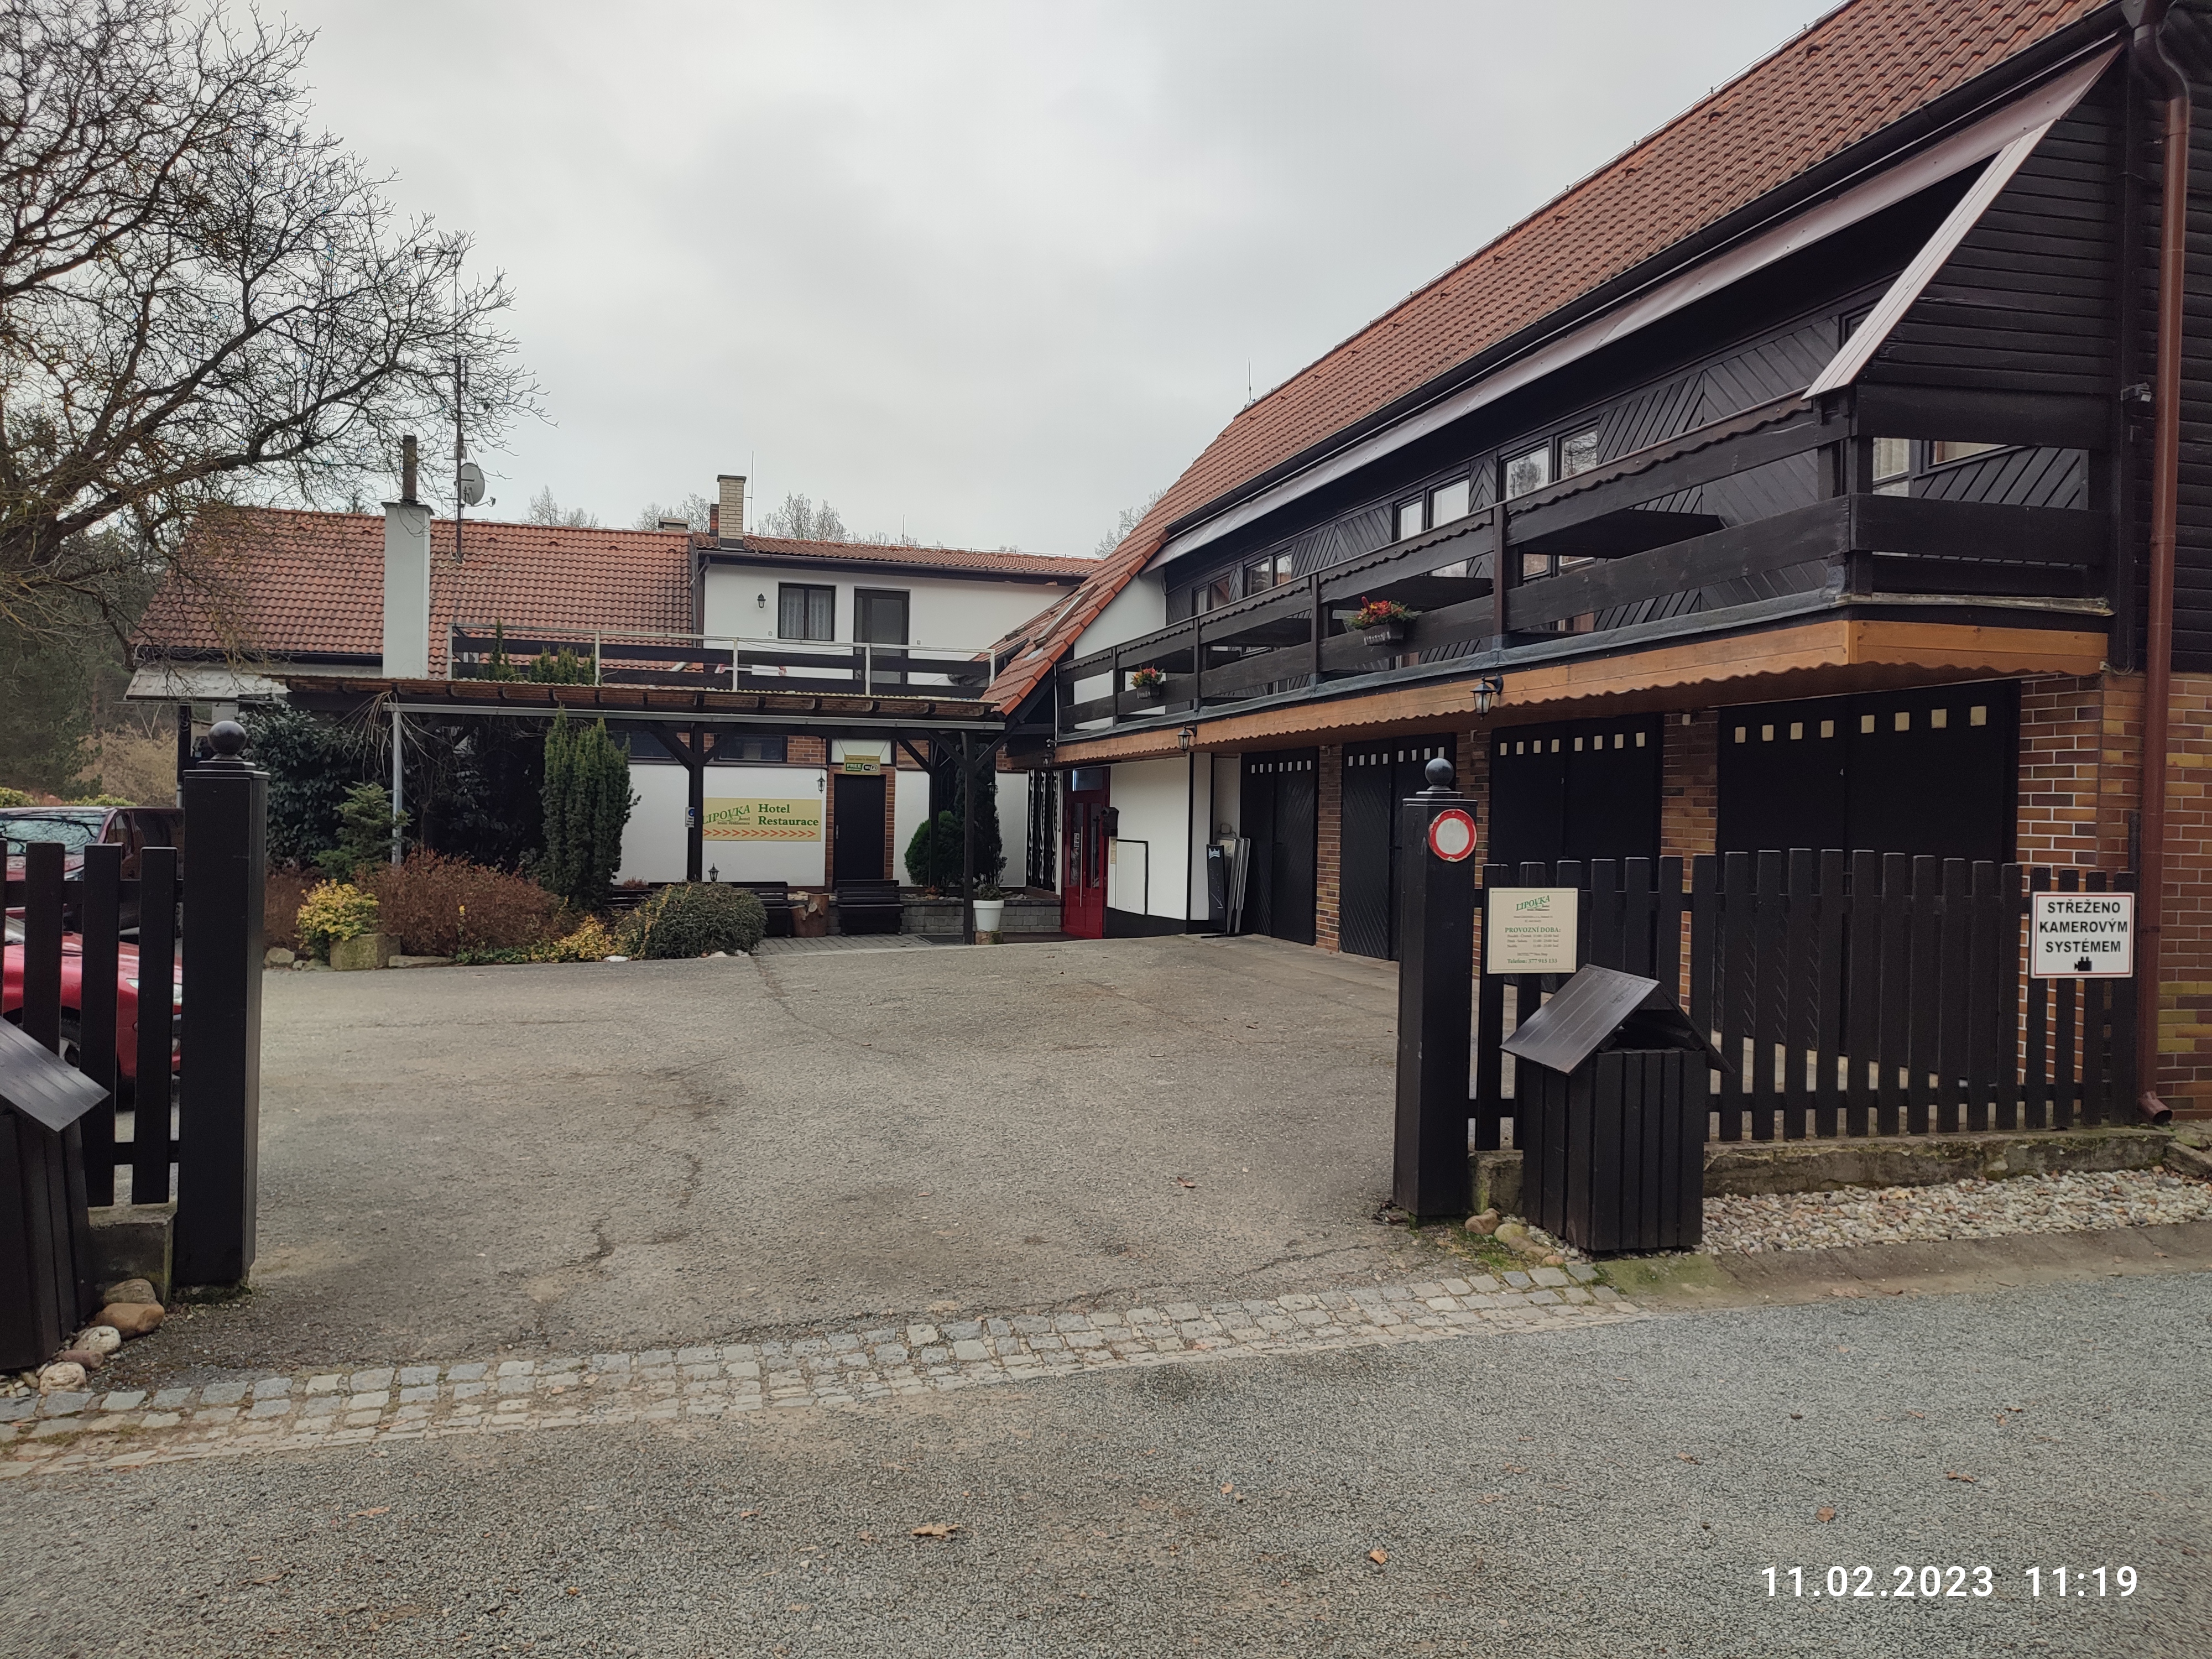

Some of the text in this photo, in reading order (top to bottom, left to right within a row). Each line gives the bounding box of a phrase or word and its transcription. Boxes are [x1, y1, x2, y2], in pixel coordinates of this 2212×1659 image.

[703, 805, 750, 825] LIPOVKA
[758, 804, 790, 813] Hotel
[758, 816, 819, 826] Restaurace
[1516, 895, 1551, 911] LIPOVKA
[2047, 899, 2121, 914] STŘEŽENO
[2039, 918, 2128, 933] KAMEROVÝM
[2045, 938, 2121, 952] SYSTÉMEM
